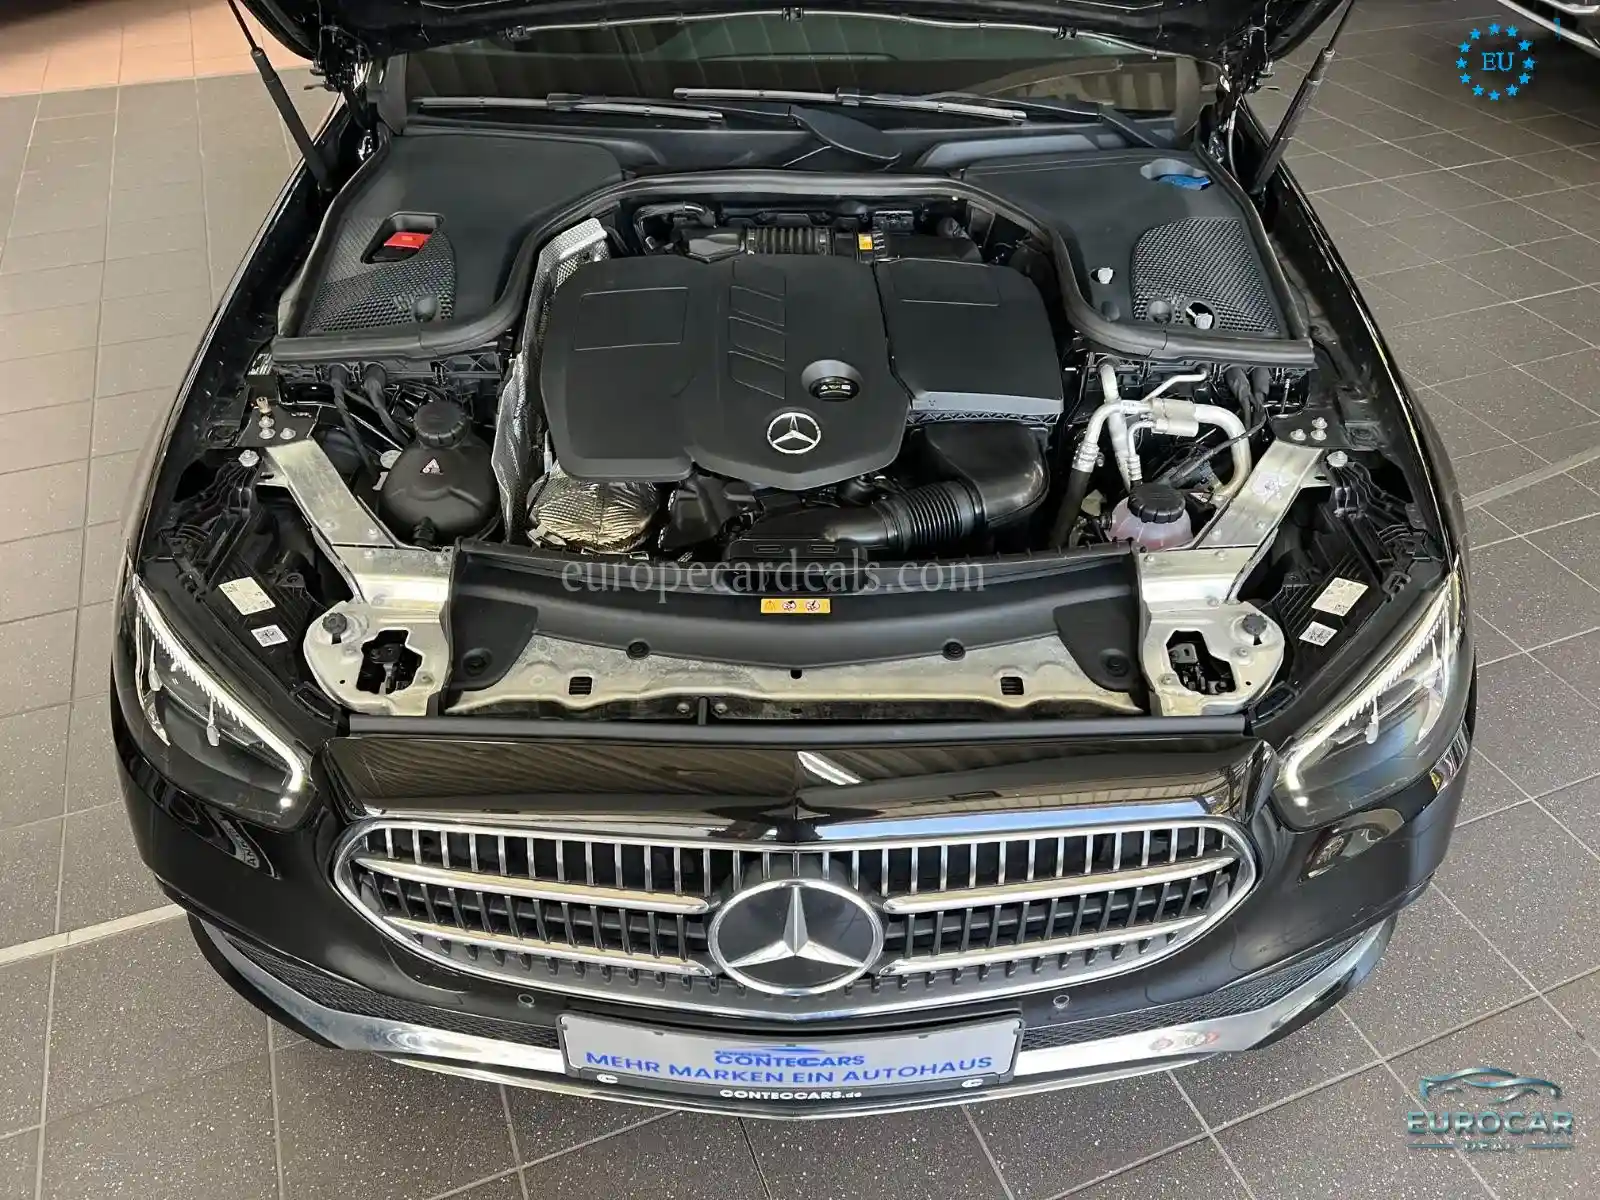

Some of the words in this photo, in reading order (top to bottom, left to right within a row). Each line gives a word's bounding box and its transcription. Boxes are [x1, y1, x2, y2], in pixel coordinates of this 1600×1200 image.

[586, 1052, 660, 1073] MEHR
[669, 1064, 784, 1083] MARKEN
[793, 1071, 834, 1083] EIN
[842, 1056, 993, 1082] AUTOHAUS
